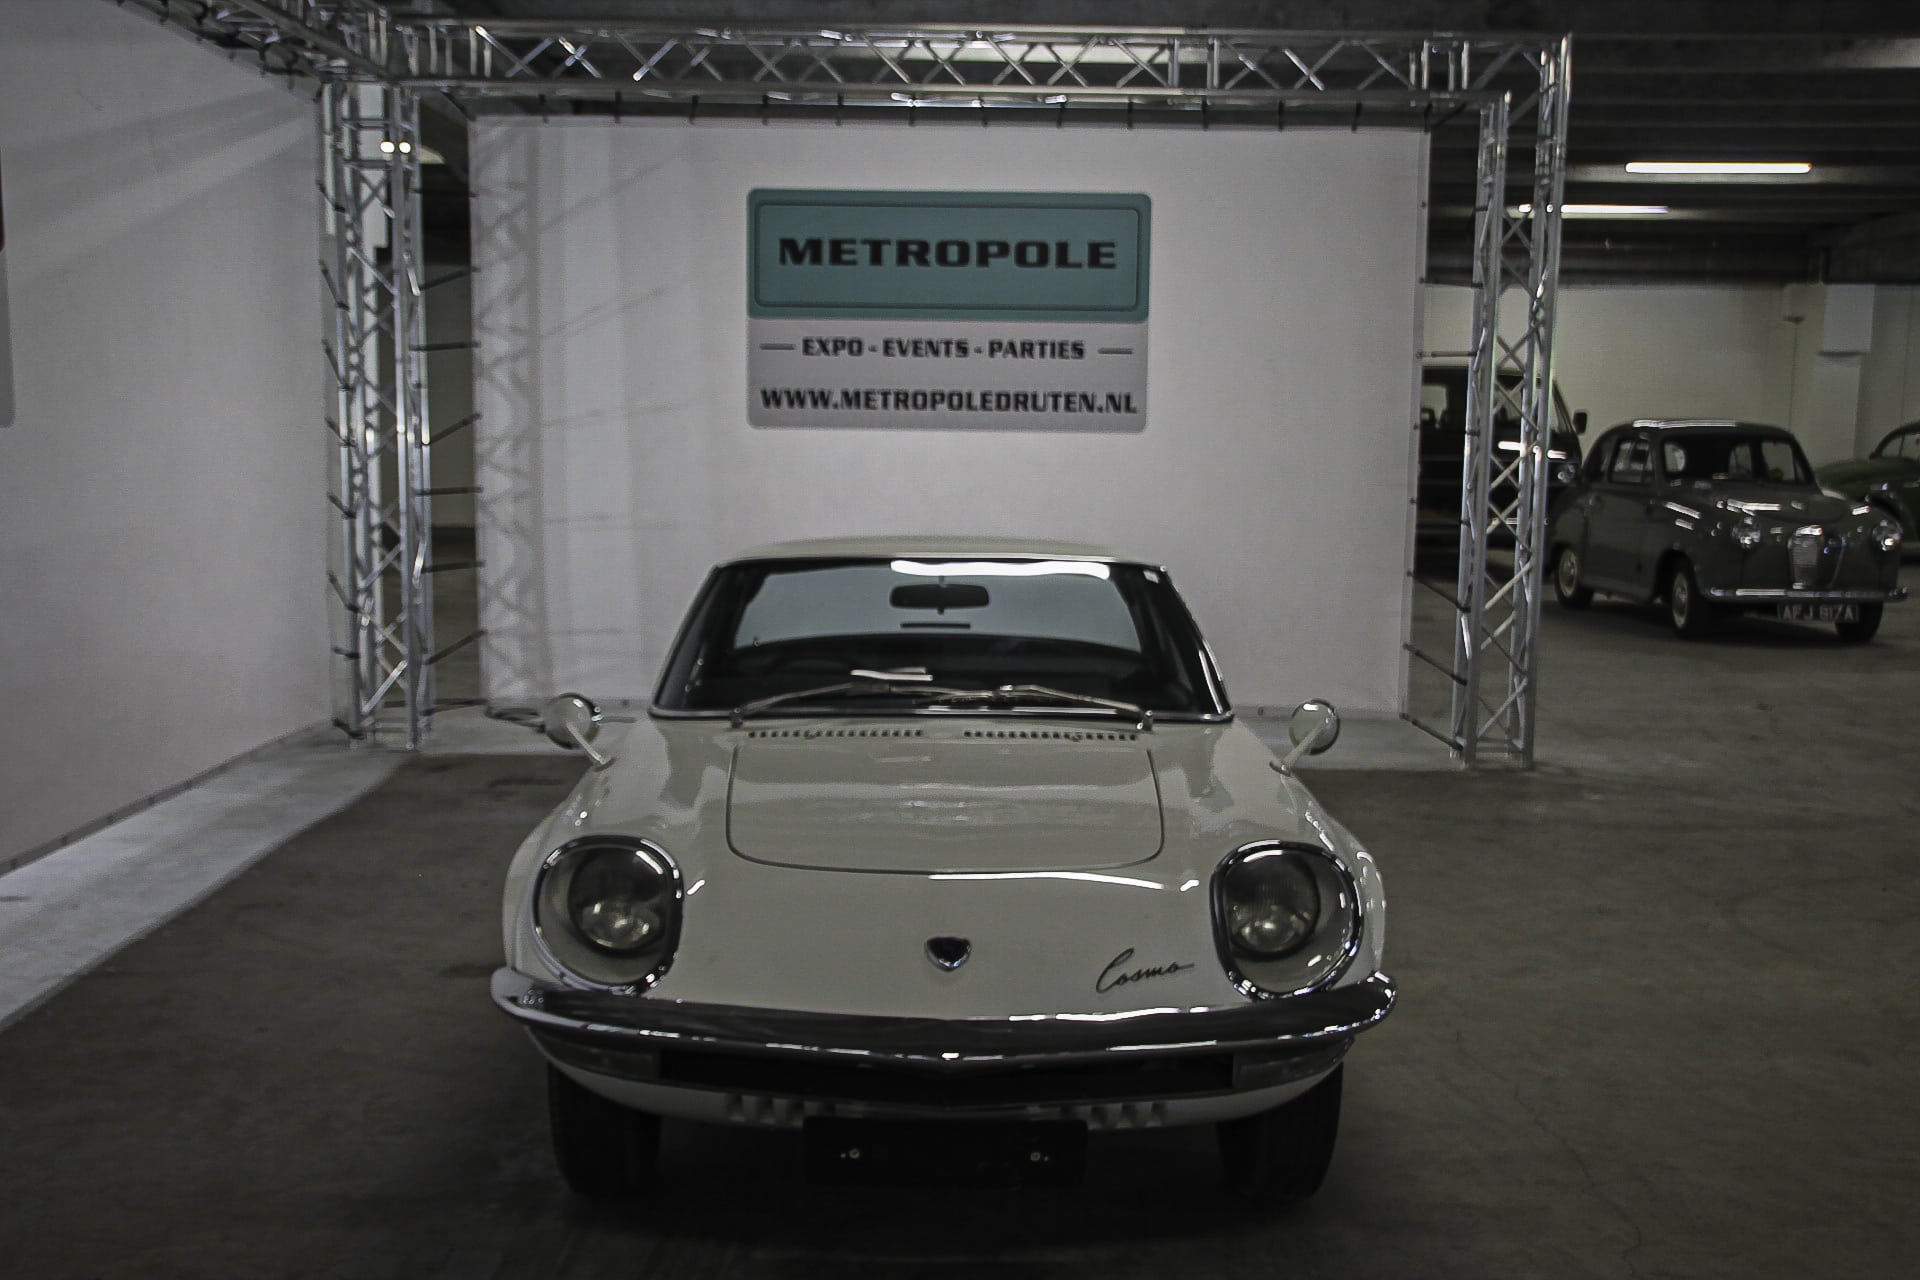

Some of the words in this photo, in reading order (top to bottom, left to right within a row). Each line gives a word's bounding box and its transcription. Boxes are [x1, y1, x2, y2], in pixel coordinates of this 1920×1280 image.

[778, 238, 1117, 270] METROPOLE
[802, 337, 864, 356] EXPO
[882, 338, 968, 357] EVENTS
[988, 340, 1084, 359] PARTIES
[760, 388, 1137, 414] WWW.METROPOLEDRUTEN.NL
[1096, 948, 1195, 993] Cosmo
